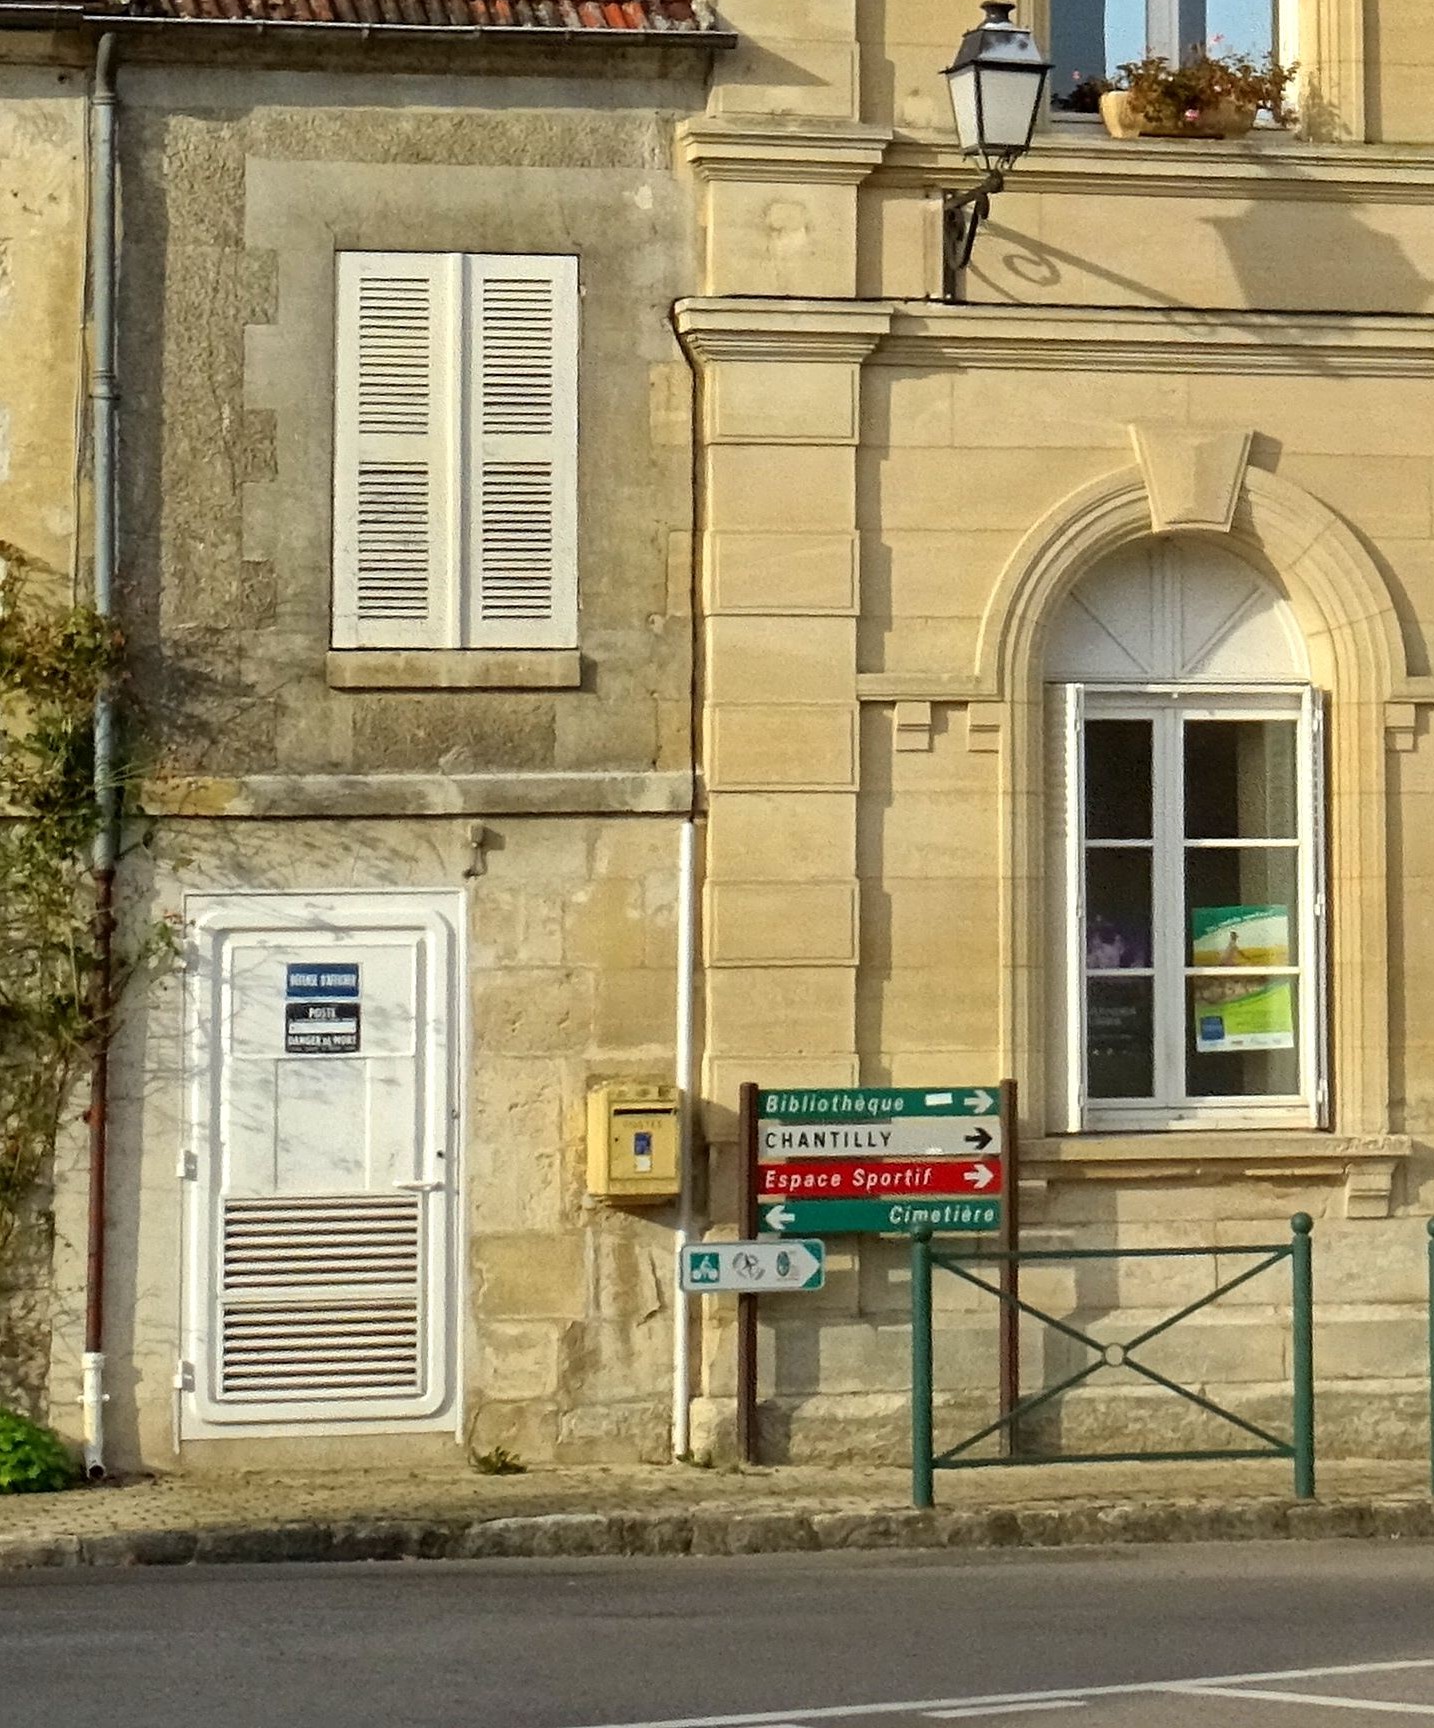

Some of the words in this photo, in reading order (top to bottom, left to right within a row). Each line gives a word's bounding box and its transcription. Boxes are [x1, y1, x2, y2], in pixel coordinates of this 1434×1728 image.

[765, 1094, 905, 1114] Bibliothèque
[765, 1131, 892, 1149] CHANTILLY
[765, 1170, 842, 1192] Espace
[852, 1167, 932, 1191] Sportif
[889, 1204, 996, 1224] Cimetière
